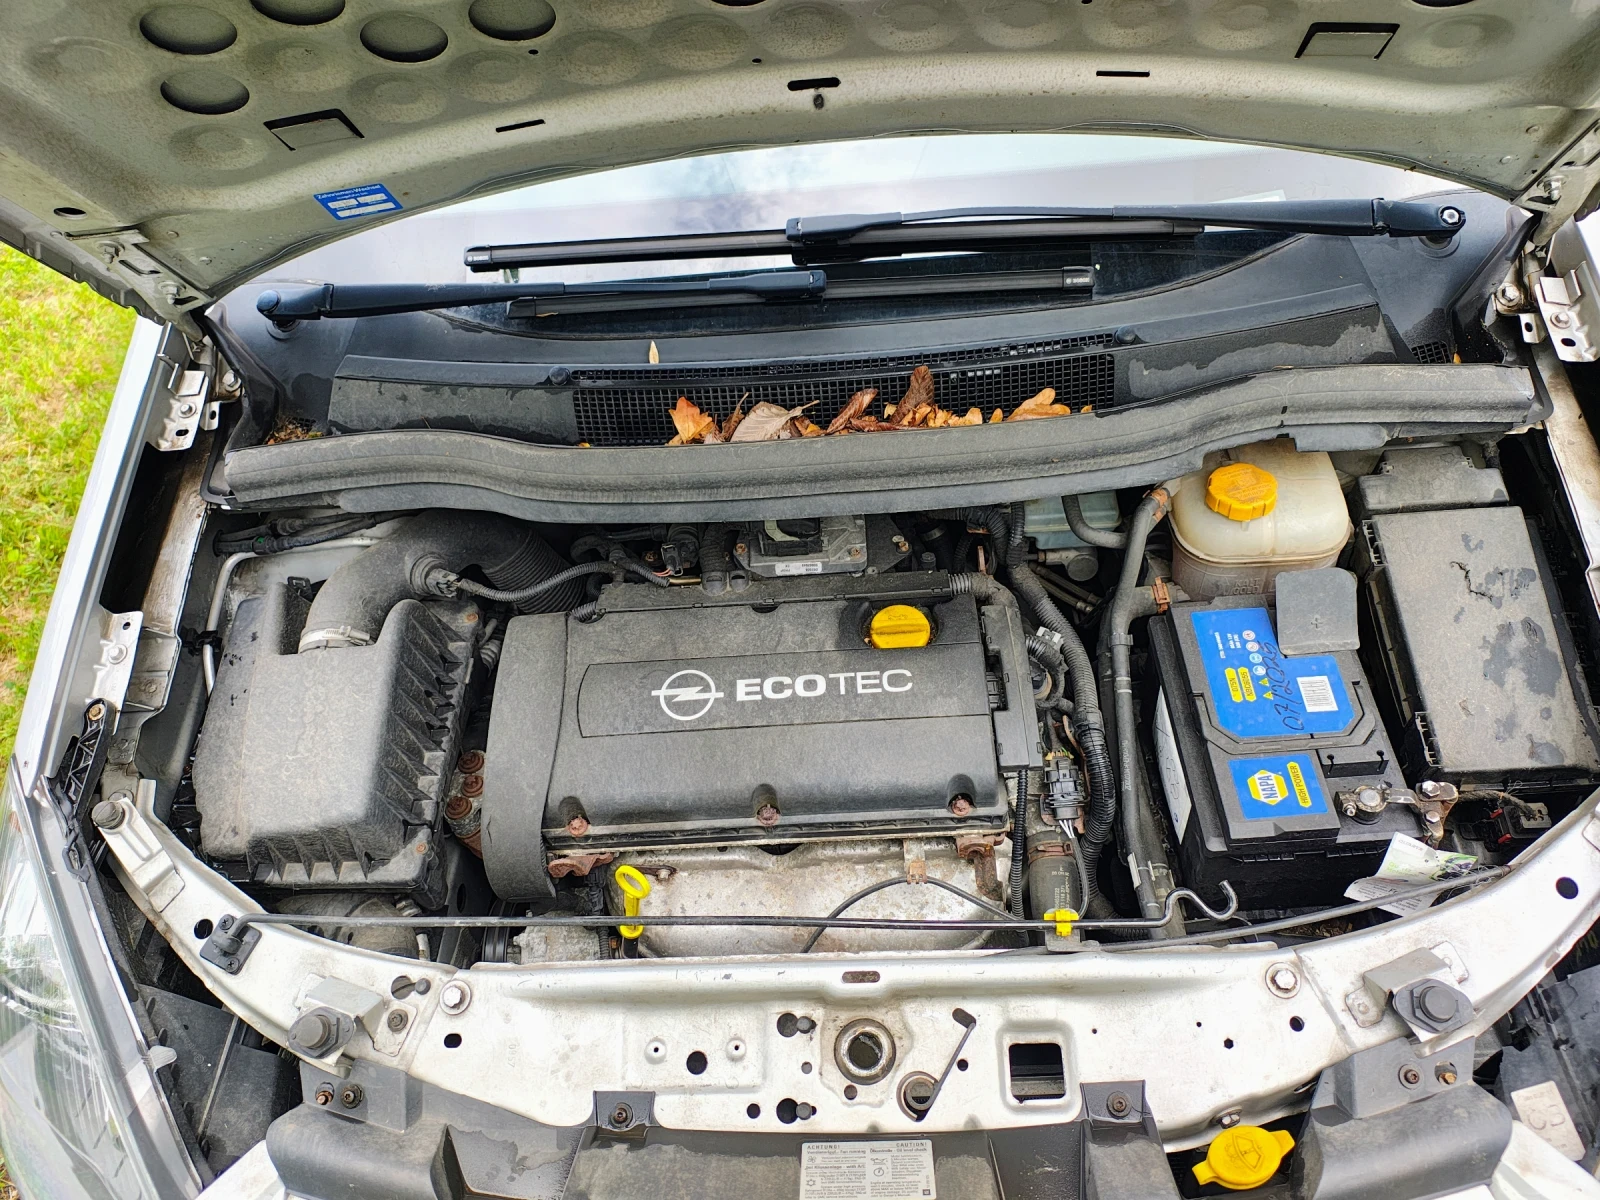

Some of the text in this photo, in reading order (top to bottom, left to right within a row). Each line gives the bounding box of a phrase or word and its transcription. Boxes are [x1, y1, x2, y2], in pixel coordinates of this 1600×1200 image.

[736, 669, 913, 702] ECOTEC
[1257, 640, 1305, 731] 07/2025
[1257, 774, 1279, 800] NAPA
[1289, 765, 1309, 804] HIGH POWER
